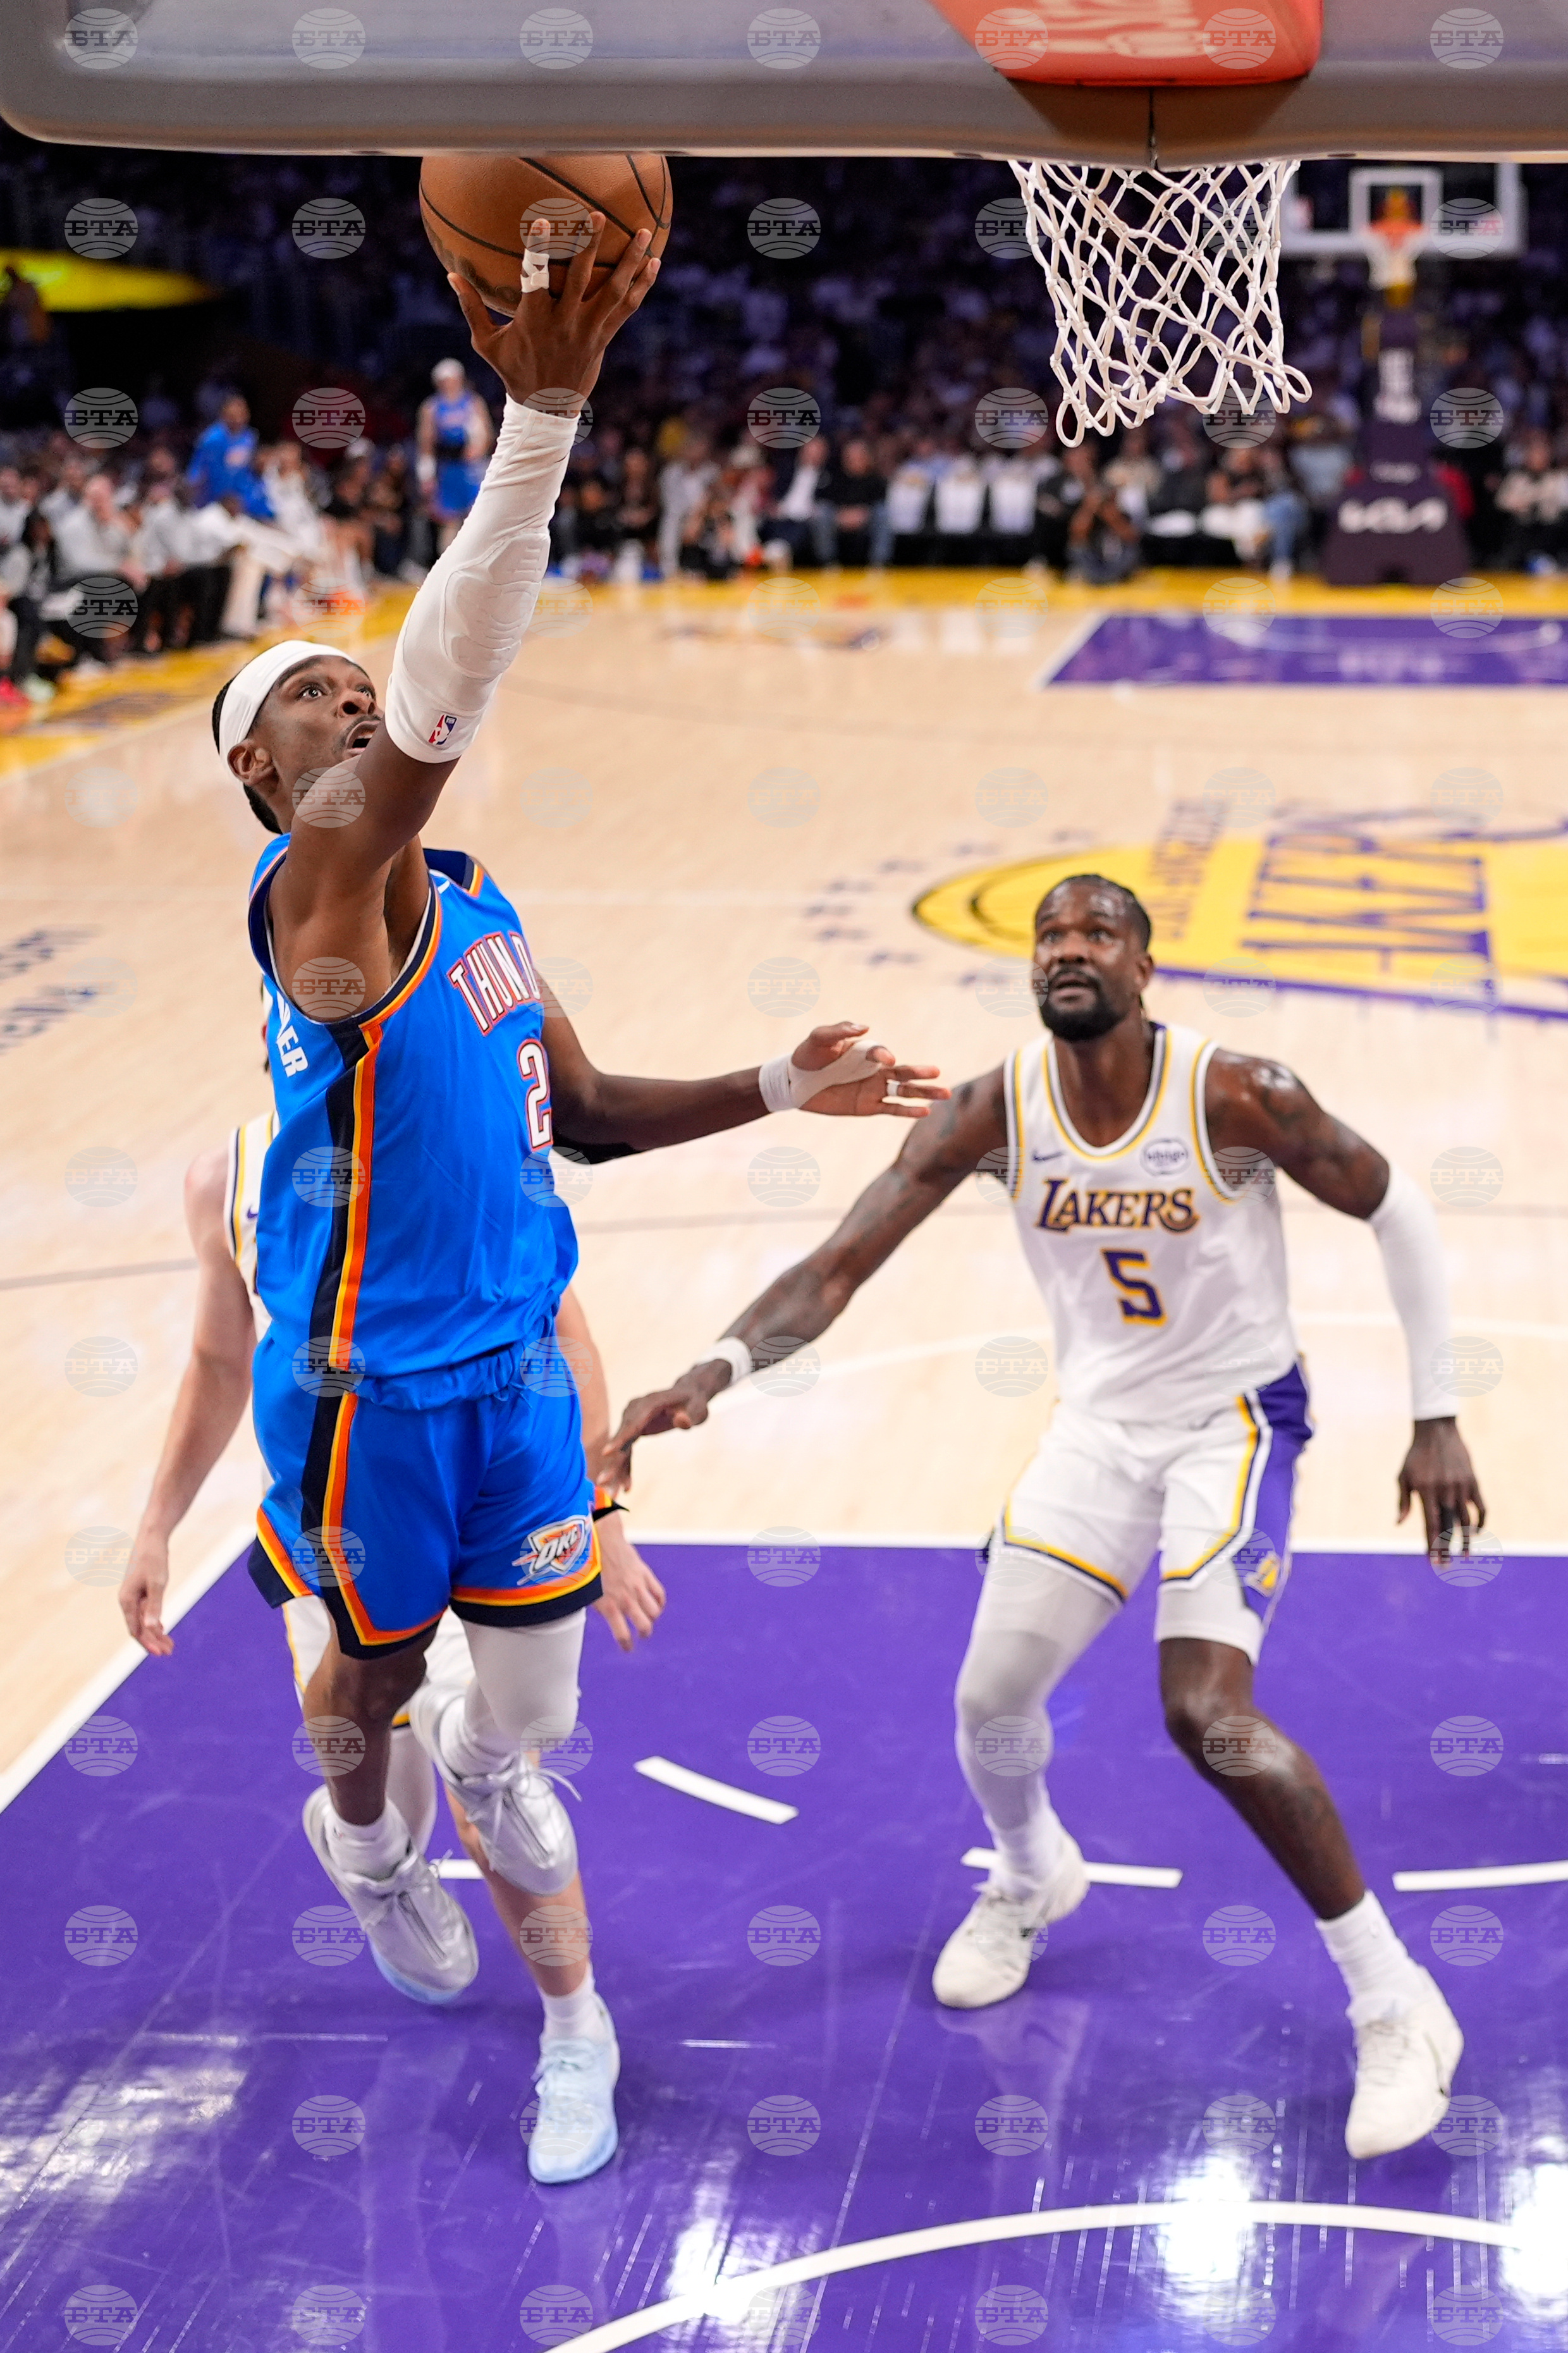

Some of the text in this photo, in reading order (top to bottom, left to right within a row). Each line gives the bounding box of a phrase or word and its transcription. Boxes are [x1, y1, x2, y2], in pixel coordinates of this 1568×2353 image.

[517, 1038, 554, 1152] 2
[1036, 1177, 1200, 1234] LAKERS
[1100, 1249, 1168, 1327] 5
